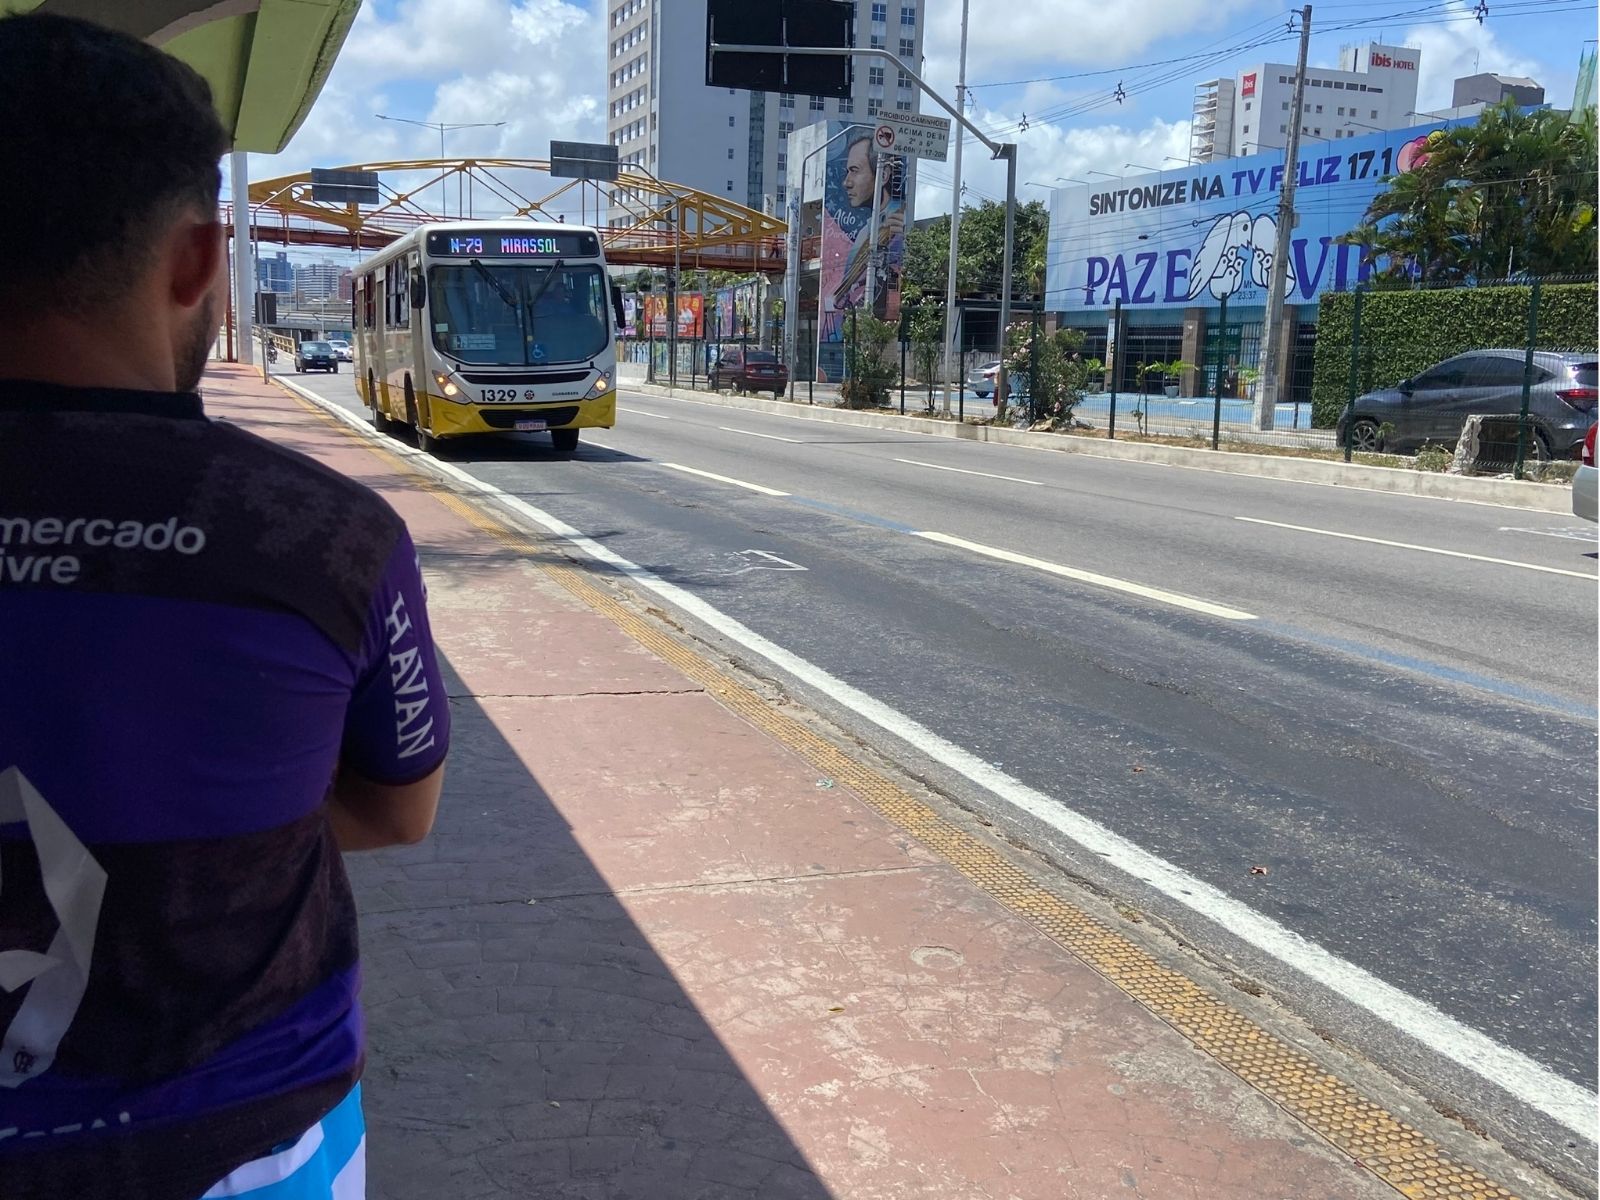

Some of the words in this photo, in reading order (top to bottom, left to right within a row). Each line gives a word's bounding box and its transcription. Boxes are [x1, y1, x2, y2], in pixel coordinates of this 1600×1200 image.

[1371, 52, 1392, 68] ibis
[1393, 60, 1416, 71] HOTEL
[879, 110, 910, 122] PROIBIDO
[898, 127, 923, 137] ACIMA
[926, 131, 938, 140] DE
[1089, 180, 1187, 216] SINTONIZE
[1190, 175, 1225, 202] NA
[1232, 168, 1266, 196] TV
[1269, 155, 1342, 192] FLIZ
[1348, 147, 1393, 180] 17.1
[829, 208, 856, 228] Aldo
[450, 238, 483, 254] N-79
[500, 238, 560, 254] MIRASSOL
[480, 389, 517, 402] 1329
[0, 516, 206, 555] mercado
[385, 591, 435, 759] HAVAN
